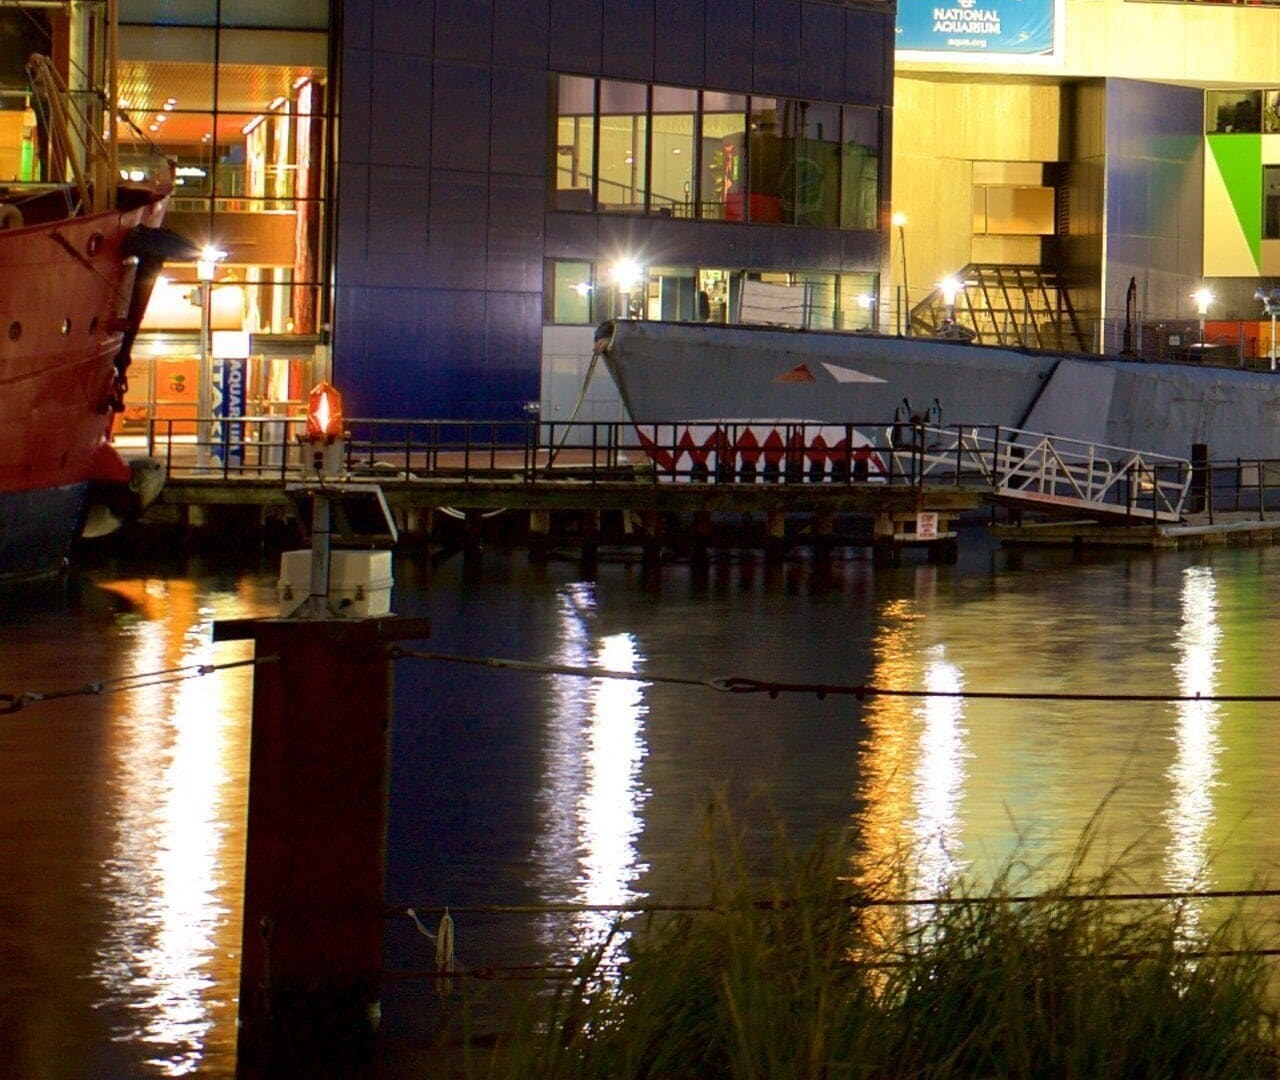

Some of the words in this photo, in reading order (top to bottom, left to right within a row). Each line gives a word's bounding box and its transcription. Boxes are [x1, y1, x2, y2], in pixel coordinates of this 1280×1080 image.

[933, 8, 1000, 22] NATIONAL
[933, 21, 1001, 34] AQUARIUM
[228, 359, 242, 452] AQUARUM
